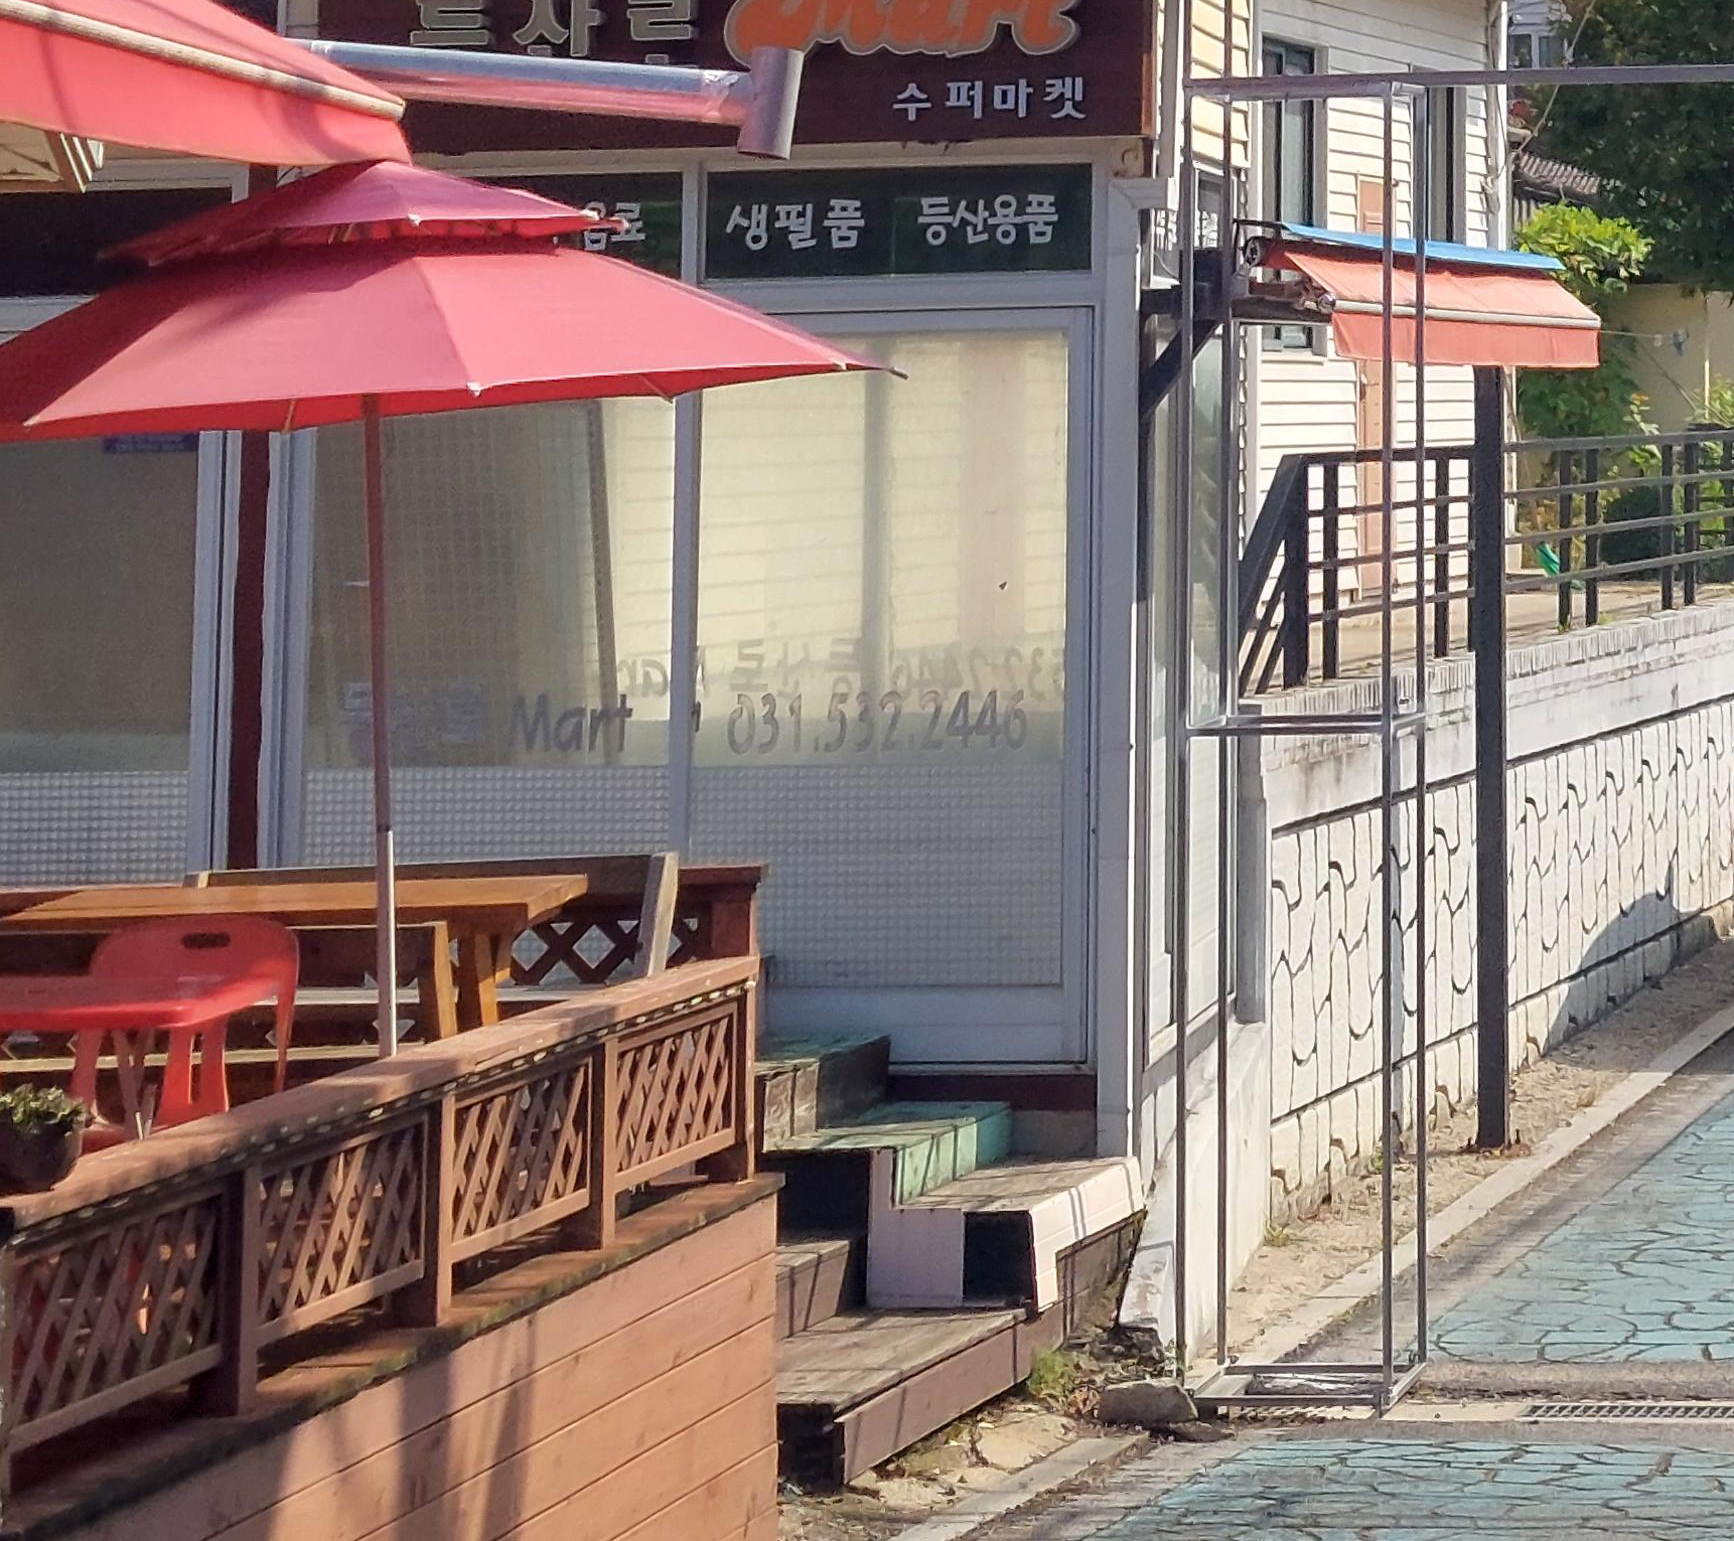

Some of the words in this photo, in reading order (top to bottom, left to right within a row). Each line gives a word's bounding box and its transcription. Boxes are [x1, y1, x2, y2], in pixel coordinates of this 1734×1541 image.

[892, 75, 1087, 123] 수퍼마켓
[725, 197, 868, 251] 생필품
[917, 195, 1061, 248] 등산용품
[513, 692, 634, 754] Mart
